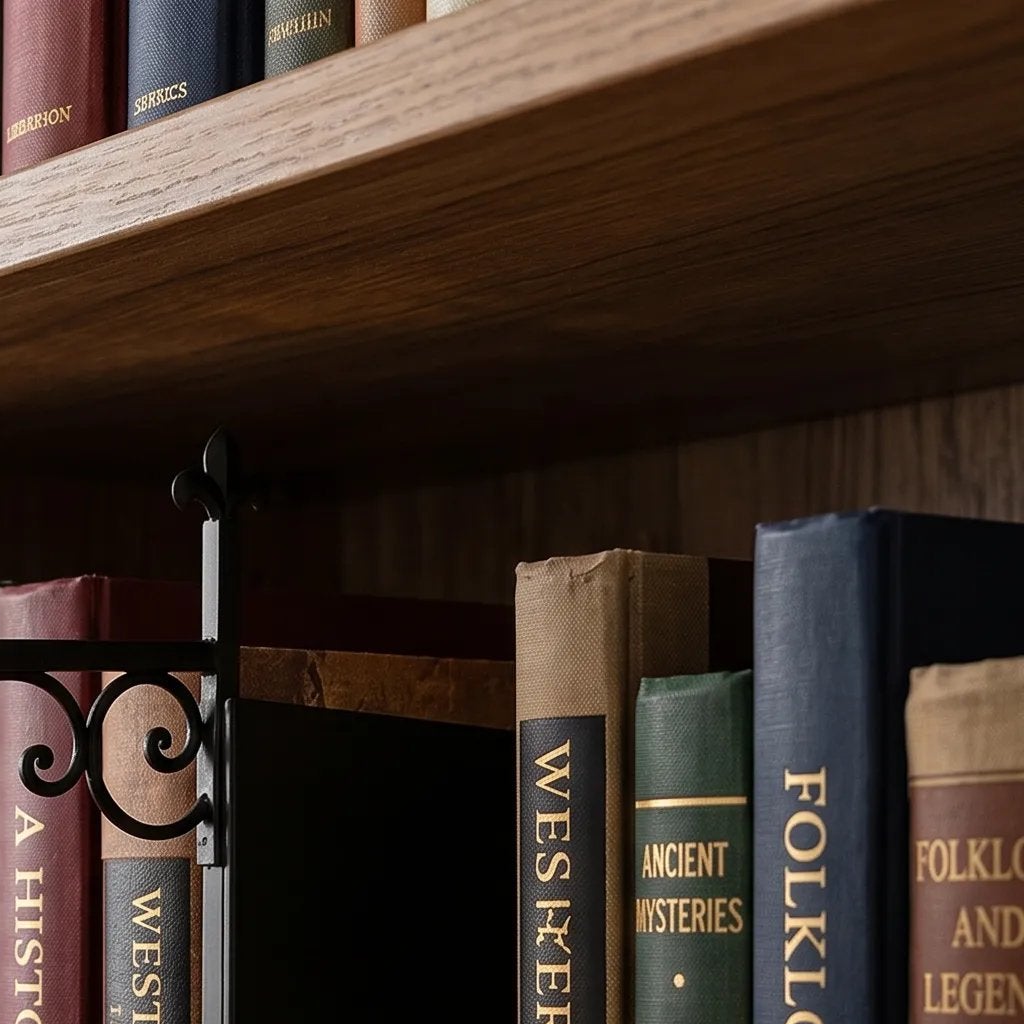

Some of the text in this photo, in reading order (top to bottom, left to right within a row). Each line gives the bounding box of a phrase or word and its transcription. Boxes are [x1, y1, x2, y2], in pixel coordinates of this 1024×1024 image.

[14, 805, 46, 846] A
[641, 841, 729, 878] ANCIENT
[636, 897, 744, 934] MYSTERIES
[951, 904, 1024, 949] AND
